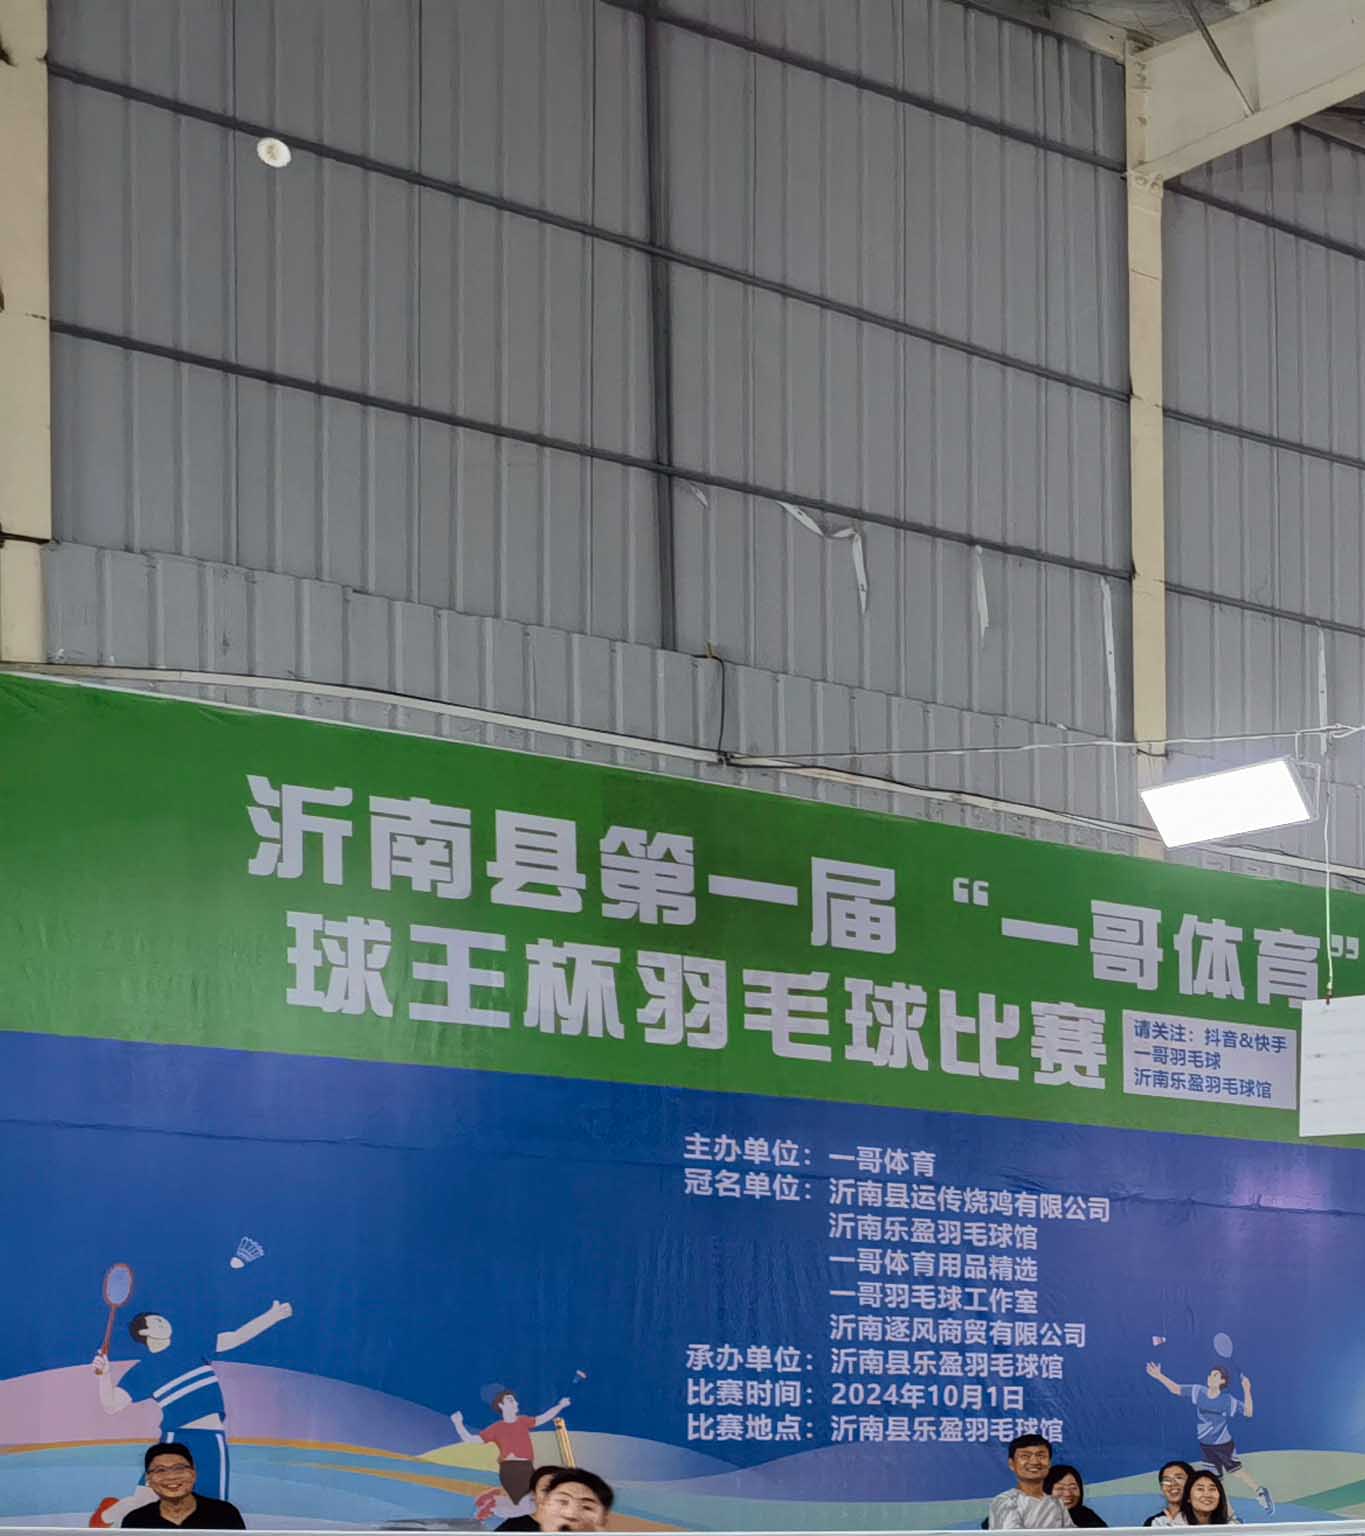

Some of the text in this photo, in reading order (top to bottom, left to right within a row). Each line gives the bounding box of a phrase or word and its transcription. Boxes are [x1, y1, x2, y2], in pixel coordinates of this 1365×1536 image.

[286, 911, 1108, 1090] 球王杯羽毛球比赛
[1134, 1045, 1221, 1070] 一哥羽毛球
[1134, 1067, 1272, 1099] 沂南乐盈羽毛球馆
[828, 1212, 1038, 1250] 沂南乐盈羽毛球馆
[829, 1248, 1038, 1282] 一哥体育用品精选
[829, 1282, 1038, 1314] 一哥羽毛球工作室
[829, 1315, 1086, 1348] 沂南逐风商贸有限公司
